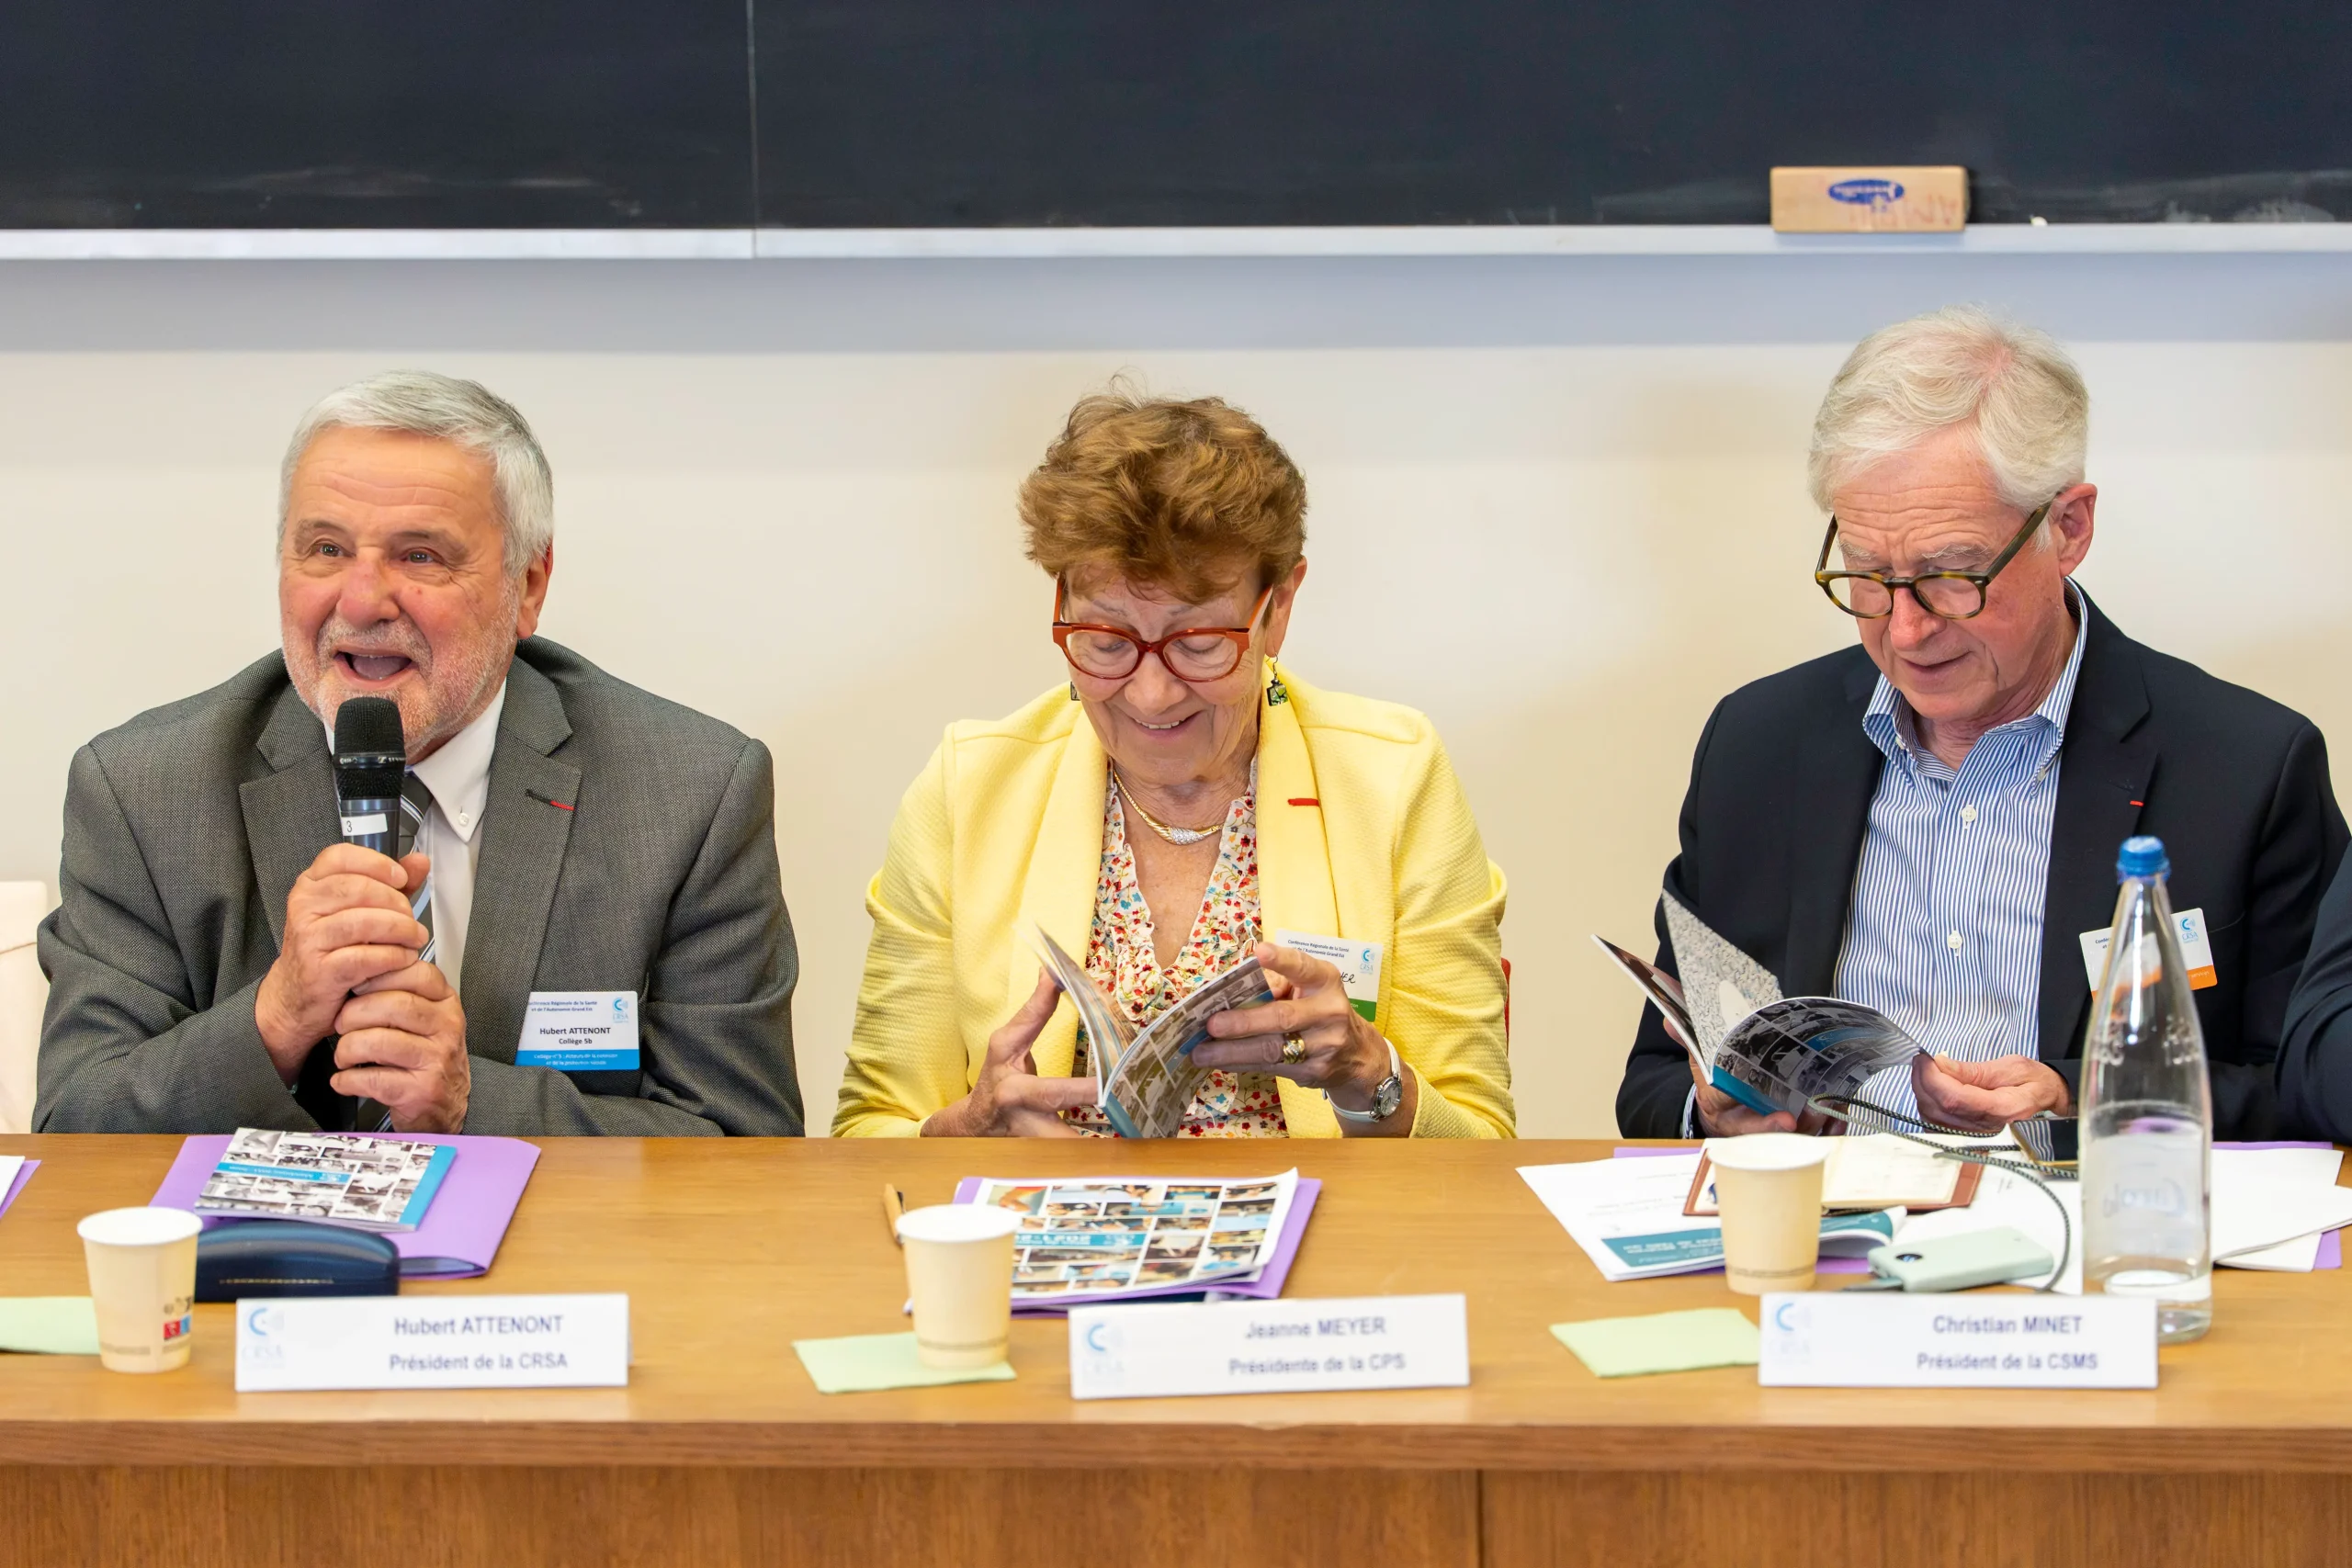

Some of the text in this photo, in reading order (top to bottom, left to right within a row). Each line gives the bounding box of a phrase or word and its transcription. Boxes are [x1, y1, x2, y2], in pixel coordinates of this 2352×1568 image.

[346, 820, 353, 833] 3
[1287, 939, 1310, 948] Conférence
[539, 1027, 612, 1035] Hubert ATTENONT
[559, 1037, 594, 1045] Collège 5b
[394, 1314, 563, 1336] Hubert ATTENONT
[1245, 1316, 1386, 1340] Jeanne MEYER
[1933, 1314, 2082, 1334] Christian MINET
[389, 1352, 569, 1371] Président de la CRSA
[1228, 1352, 1407, 1375] Présidente de la CPS
[1917, 1352, 2098, 1370] Président de la CSMS
